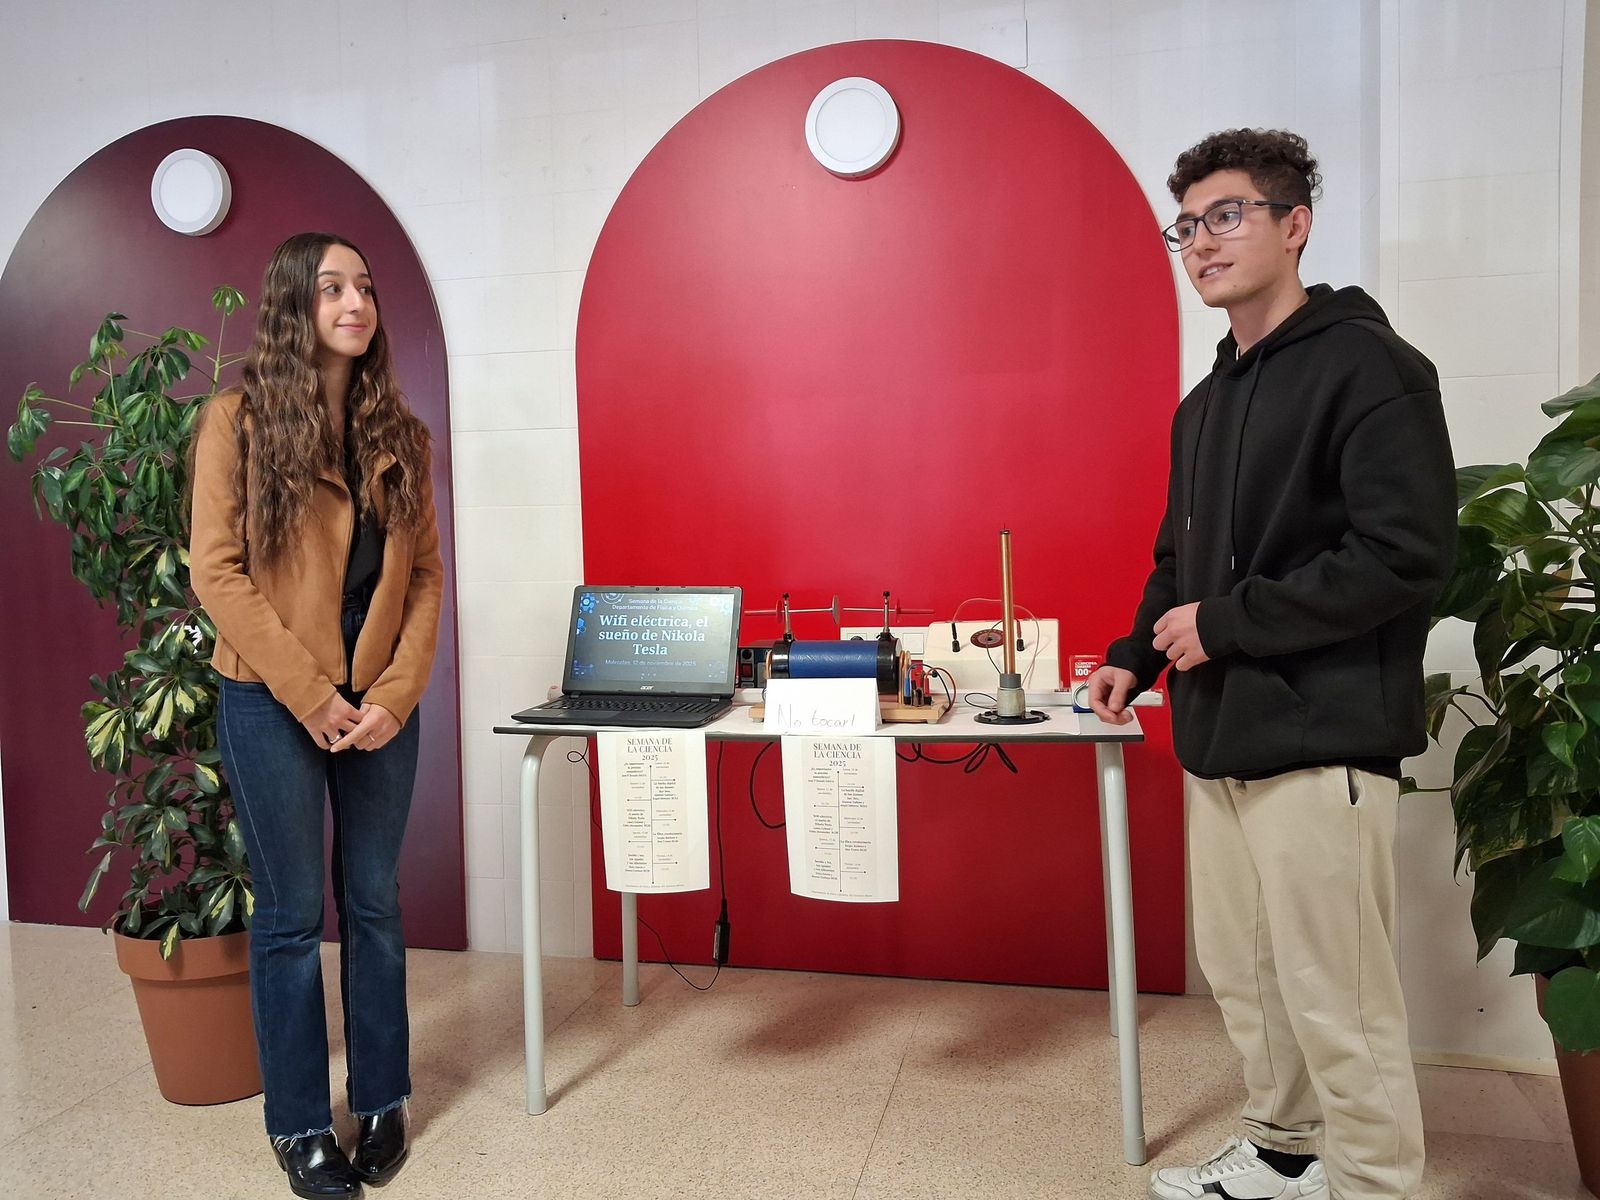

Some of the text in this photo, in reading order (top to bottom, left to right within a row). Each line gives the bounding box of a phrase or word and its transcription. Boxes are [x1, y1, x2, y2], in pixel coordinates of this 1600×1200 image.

[599, 615, 709, 628] Wifi eléctrica, el
[598, 629, 705, 642] sueño de Nikola
[633, 644, 668, 655] Tesla
[777, 703, 802, 729] No
[627, 737, 673, 746] SEMANA DE
[627, 745, 673, 753] LA CIENCIA
[813, 743, 862, 752] SEMANA DE
[642, 754, 659, 762] 2025
[813, 751, 862, 760] LA CIENCIA
[829, 760, 847, 768] 2025
